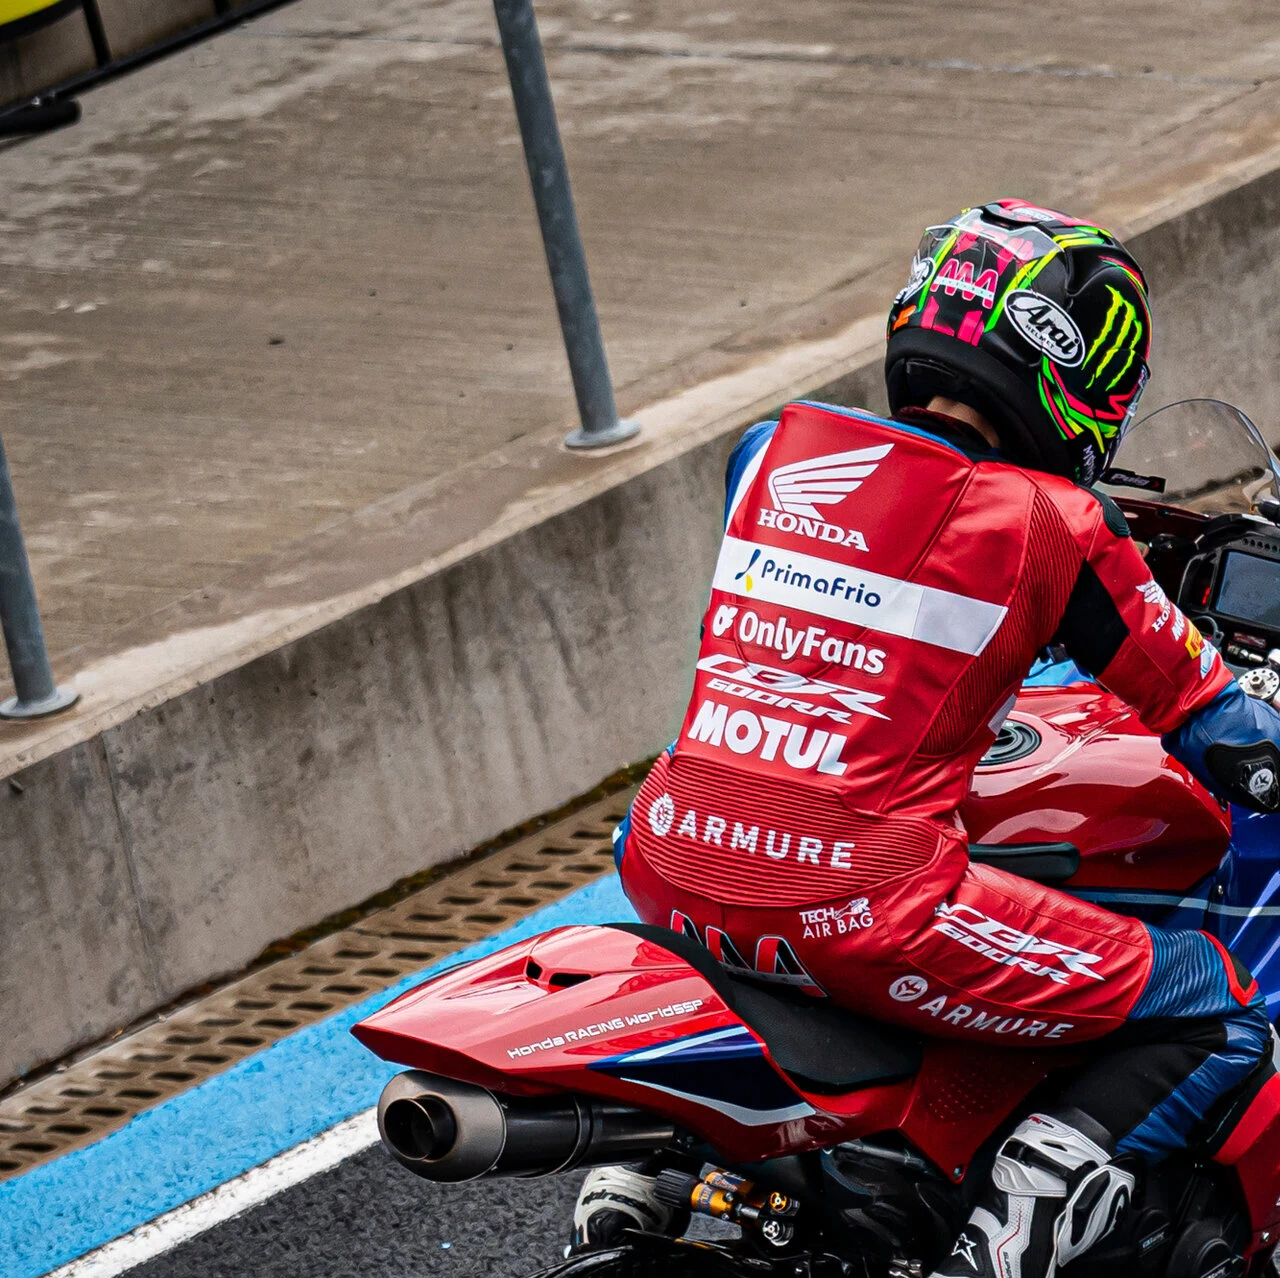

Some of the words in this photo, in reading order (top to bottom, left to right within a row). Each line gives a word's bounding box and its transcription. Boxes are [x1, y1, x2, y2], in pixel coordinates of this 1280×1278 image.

[1009, 303, 1081, 355] Arai
[1024, 324, 1057, 349] HELMET
[757, 508, 870, 552] HONDA
[761, 559, 881, 607] PrimaFrio
[739, 611, 887, 675] OnlyFans
[696, 653, 892, 721] CBR
[706, 678, 853, 726] 600RR
[687, 699, 848, 777] MOTUL
[677, 809, 856, 870] ARMURE
[802, 919, 833, 939] AIR
[836, 911, 874, 935] BAG
[934, 902, 1106, 982] CBR
[931, 922, 1072, 986] 600RR
[507, 1036, 565, 1059] Honda
[564, 1017, 625, 1043] RACING
[918, 994, 1074, 1039] ARMURE
